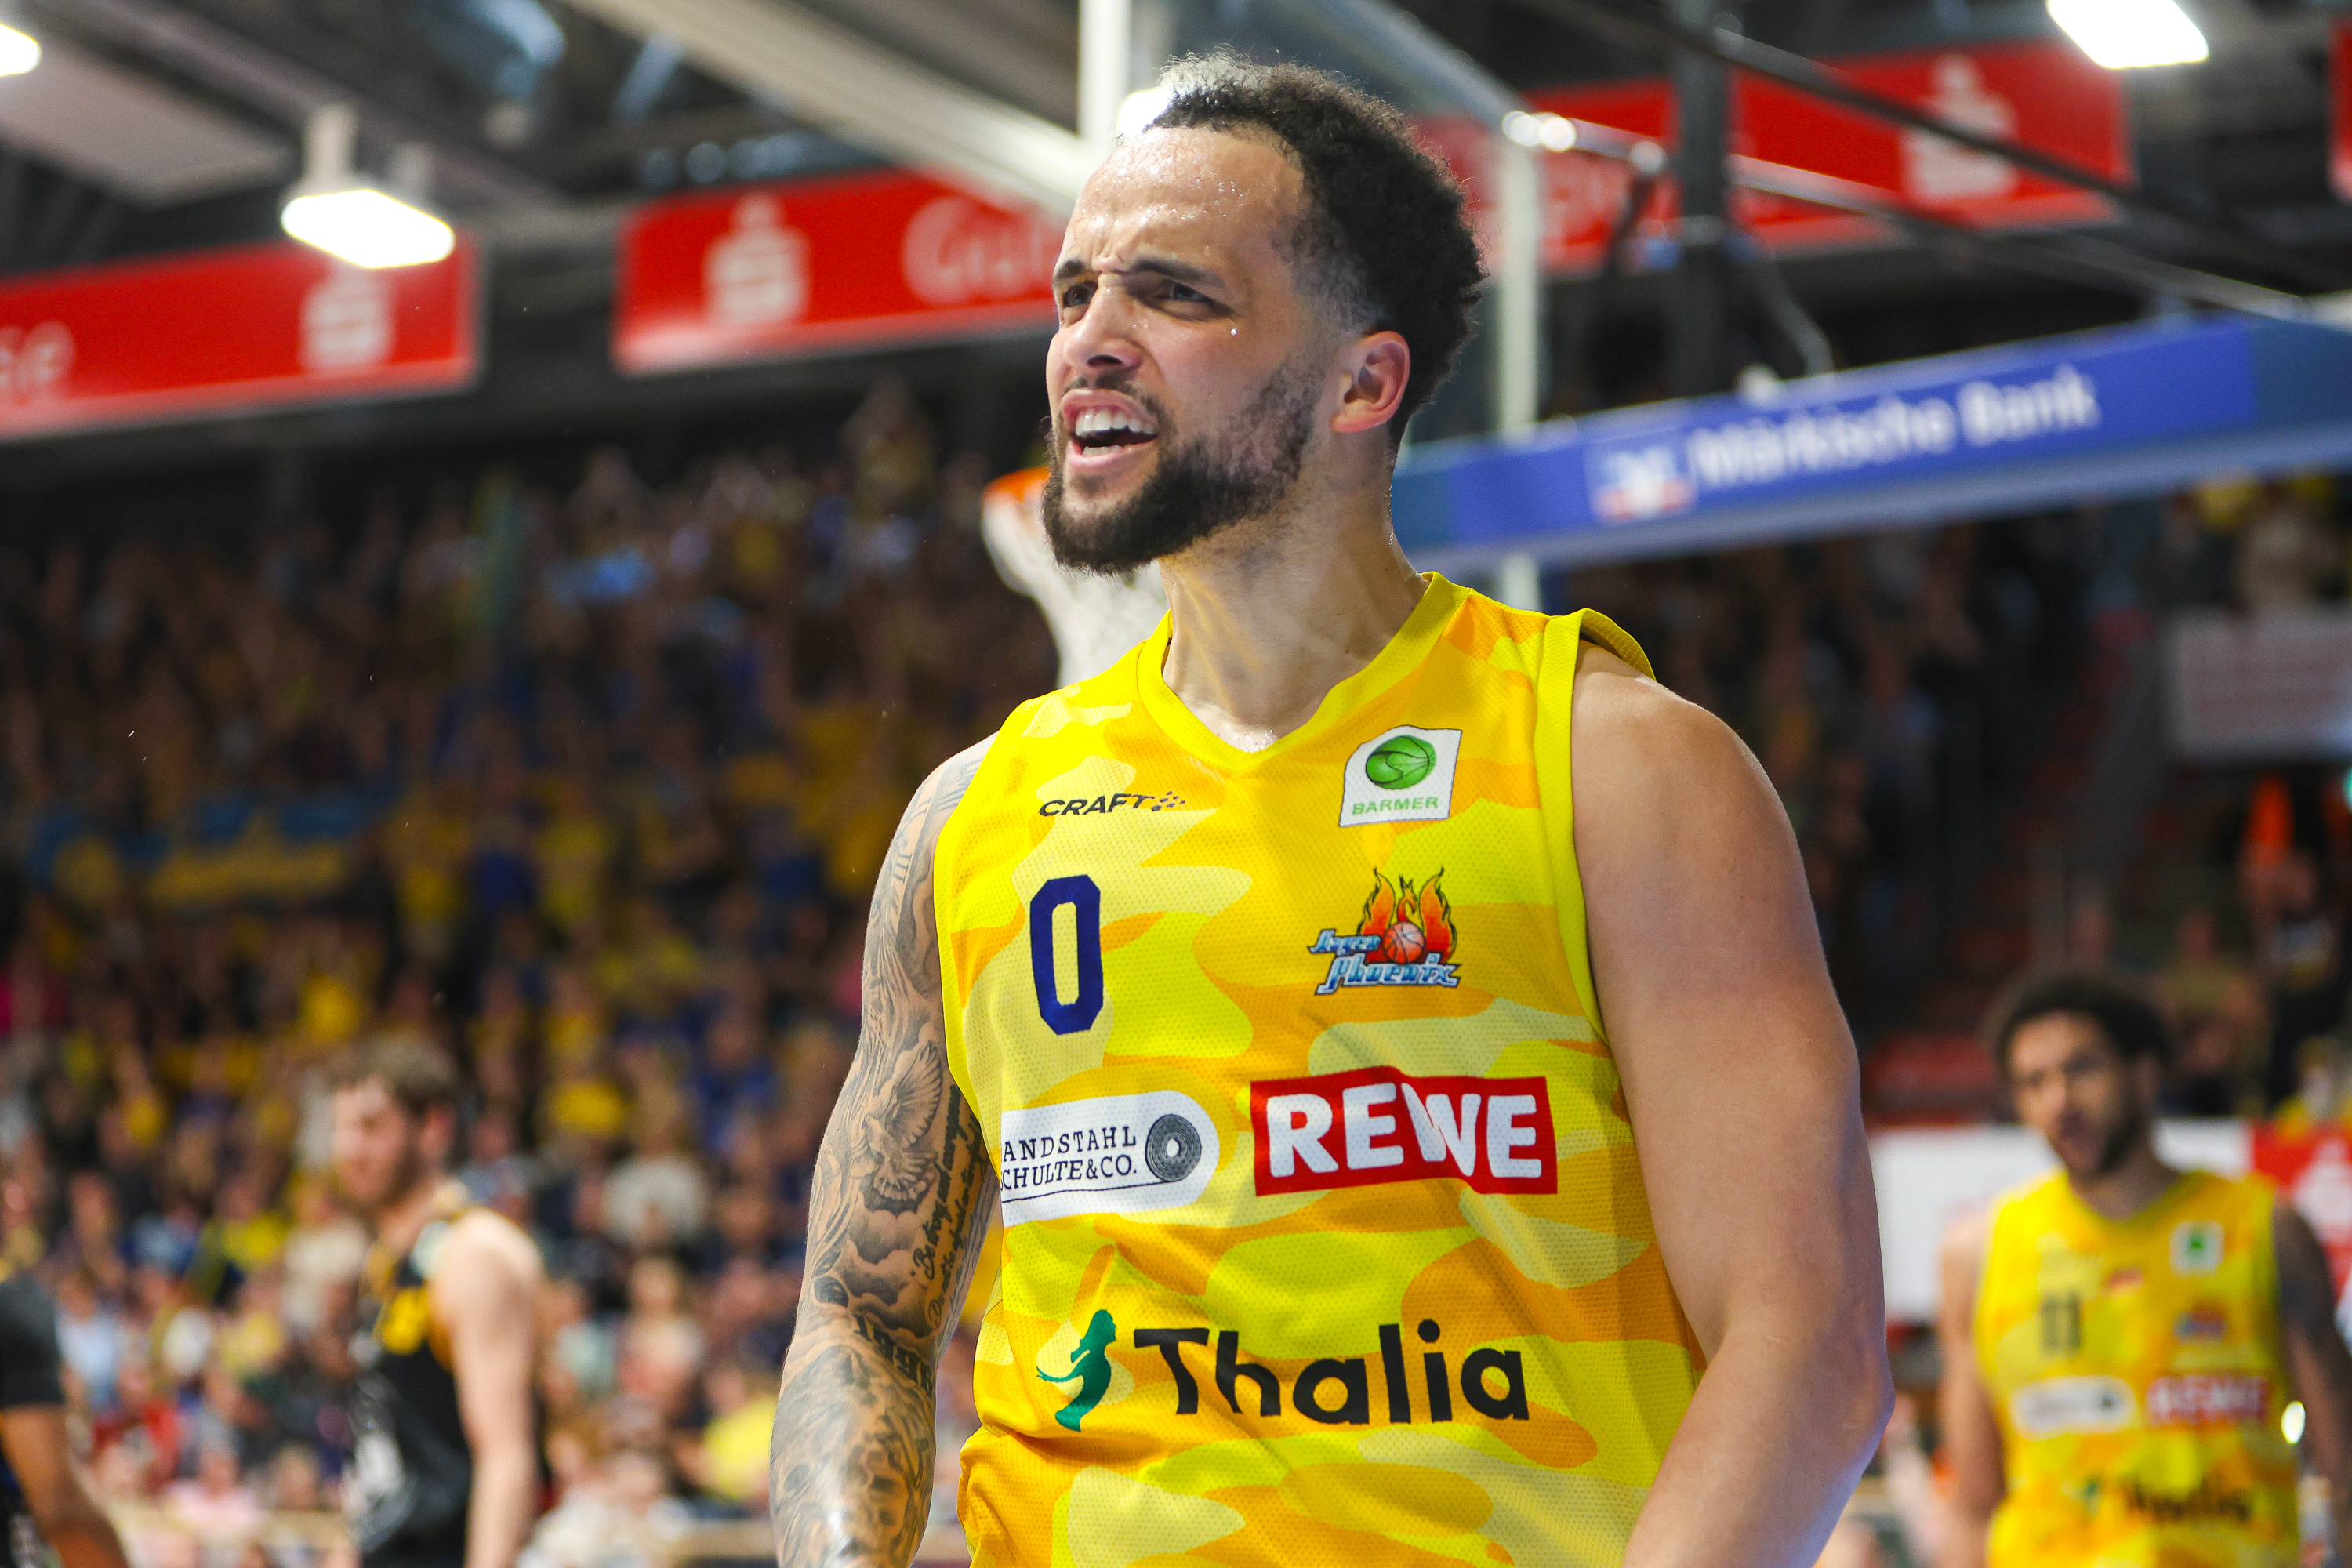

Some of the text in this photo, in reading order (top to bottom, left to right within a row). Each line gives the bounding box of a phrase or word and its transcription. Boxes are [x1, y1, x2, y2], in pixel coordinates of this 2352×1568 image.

[1959, 365, 2100, 446] Bank
[1040, 793, 1155, 815] CRAFT
[1352, 797, 1438, 815] BARMER
[1030, 874, 1103, 1035] 0
[1315, 952, 1461, 995] Phoenix
[1003, 1126, 1137, 1163] ANDSTAHL
[1266, 1082, 1541, 1178] REWE
[1134, 1319, 1530, 1425] Thalia
